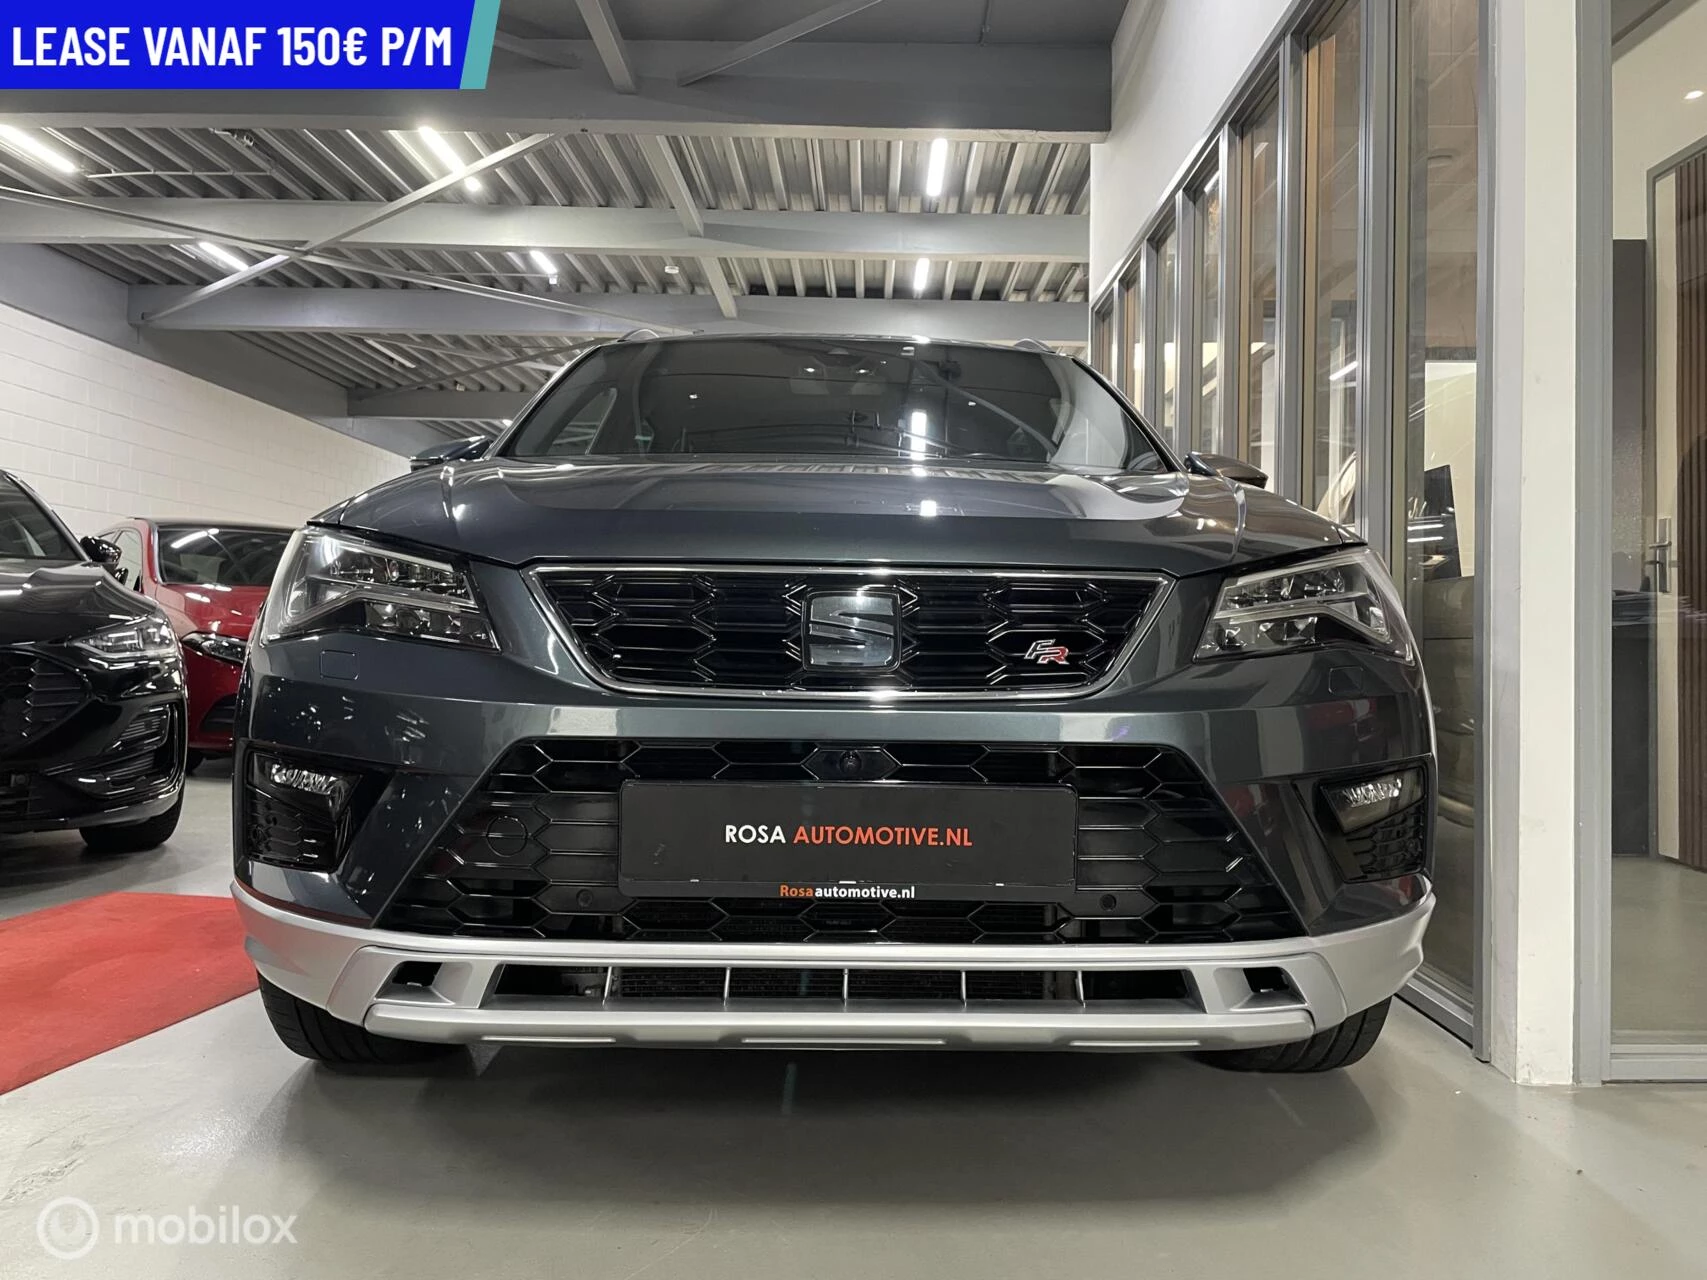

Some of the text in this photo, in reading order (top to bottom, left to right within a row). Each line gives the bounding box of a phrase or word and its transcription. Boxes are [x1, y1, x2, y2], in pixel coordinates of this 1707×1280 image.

[1024, 639, 1070, 664] FR
[725, 824, 973, 847] ROSA AUTOMOTIVE.NL
[779, 884, 915, 899] Rosaautomotive.nl
